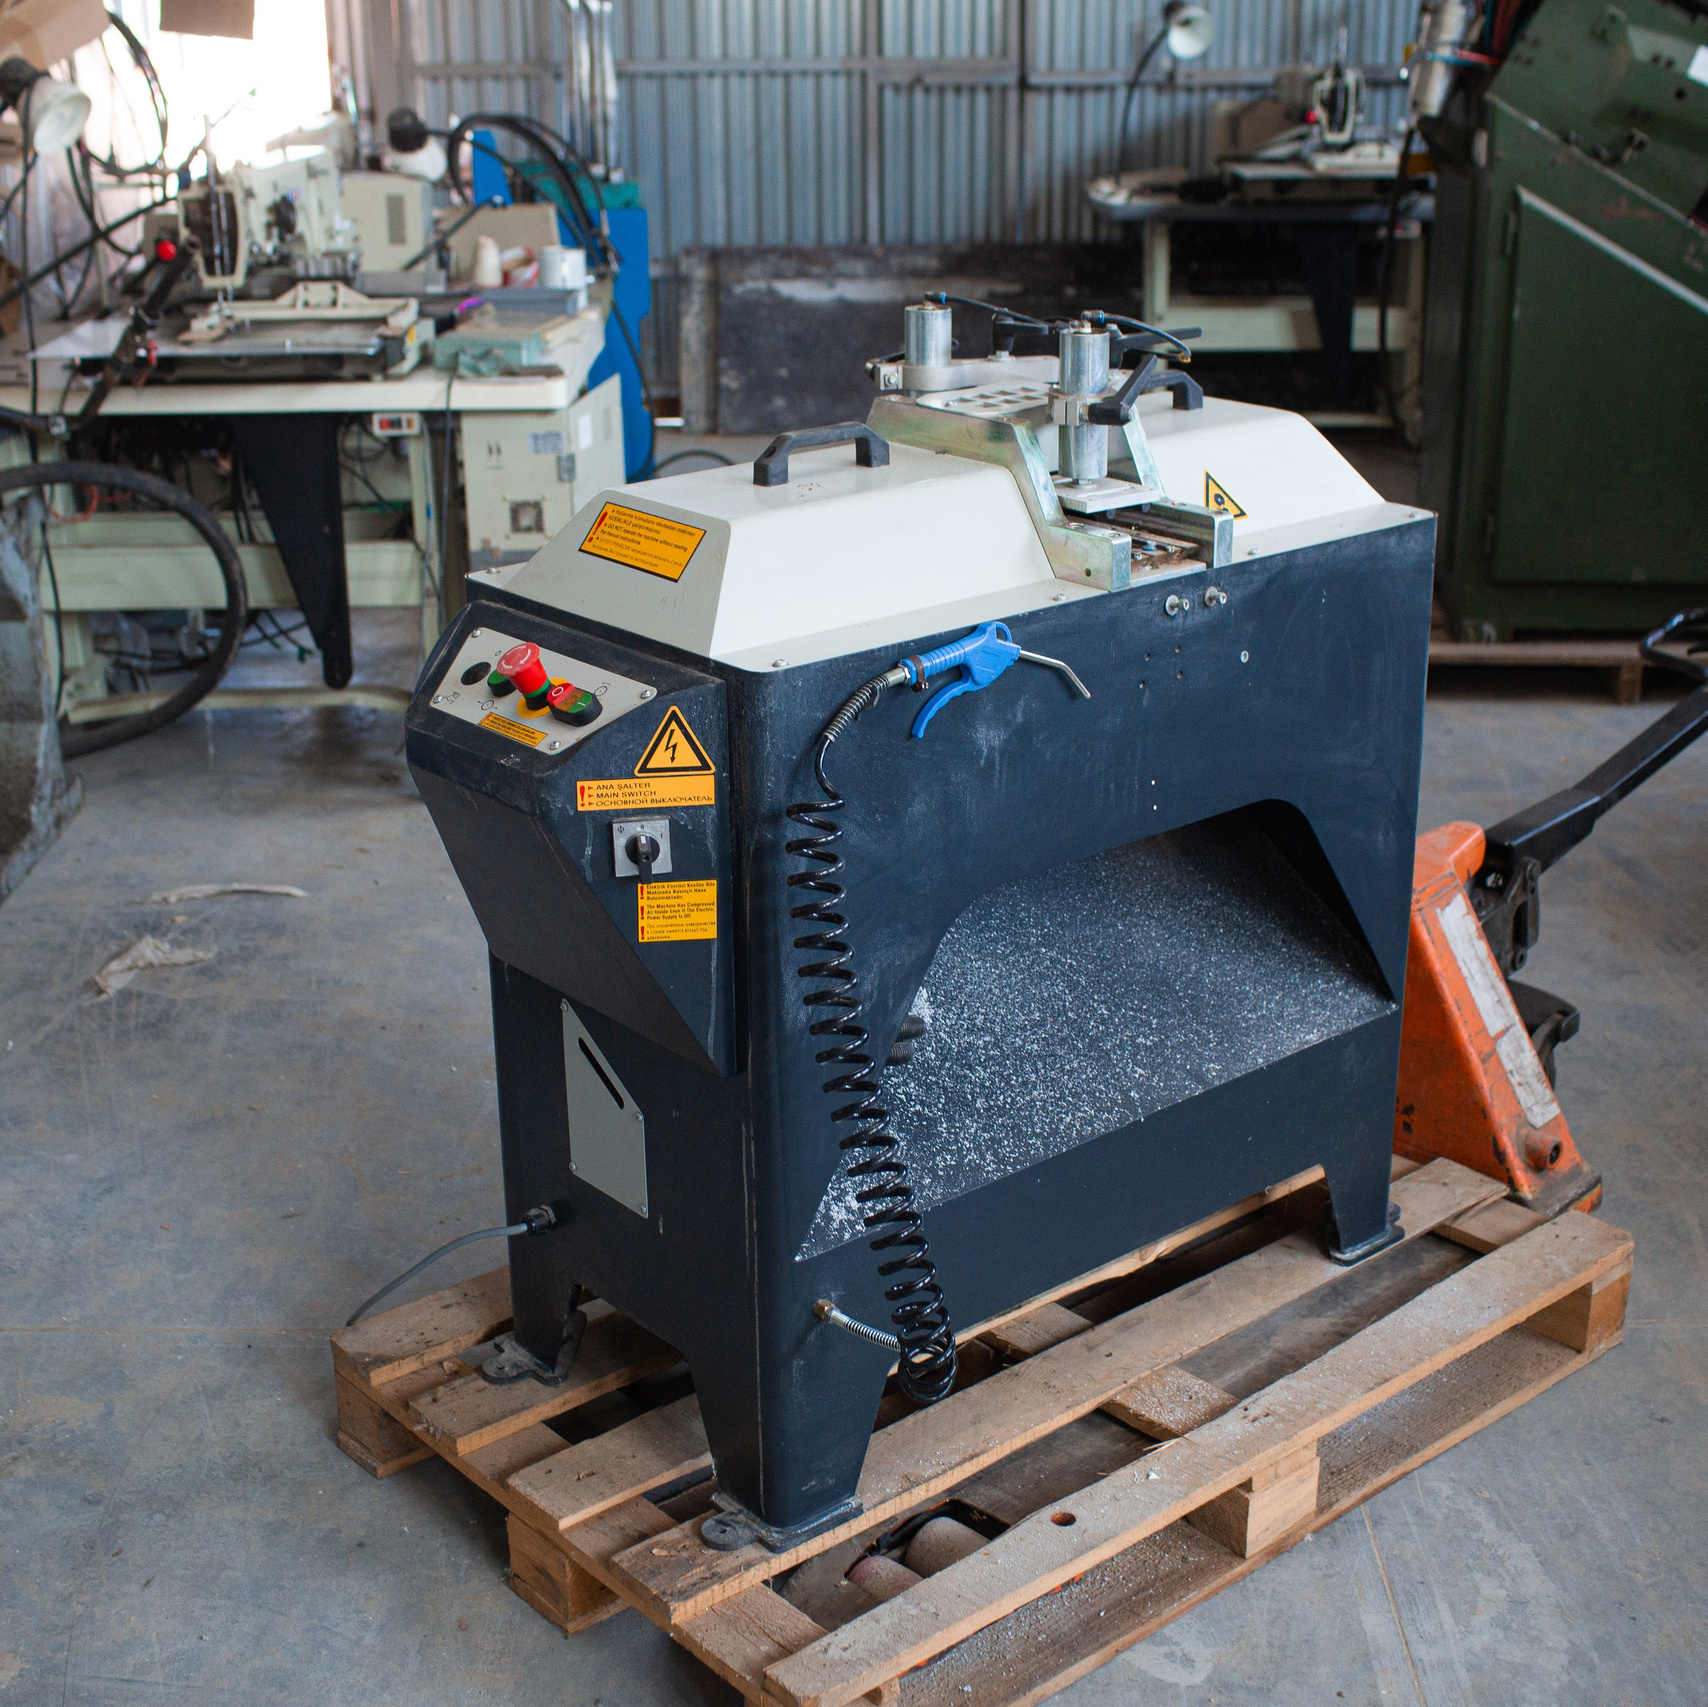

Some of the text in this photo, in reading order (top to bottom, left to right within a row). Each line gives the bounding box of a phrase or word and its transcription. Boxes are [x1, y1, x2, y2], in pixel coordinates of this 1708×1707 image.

[607, 531, 620, 539] manual
[623, 528, 636, 537] operate
[643, 533, 659, 543] machine
[659, 538, 673, 547] without
[673, 542, 688, 552] reading
[617, 782, 650, 790] ŞALTER
[596, 795, 712, 806] ОСНОВНОЙ ВЫКЛЮЧАТЕЛЬ
